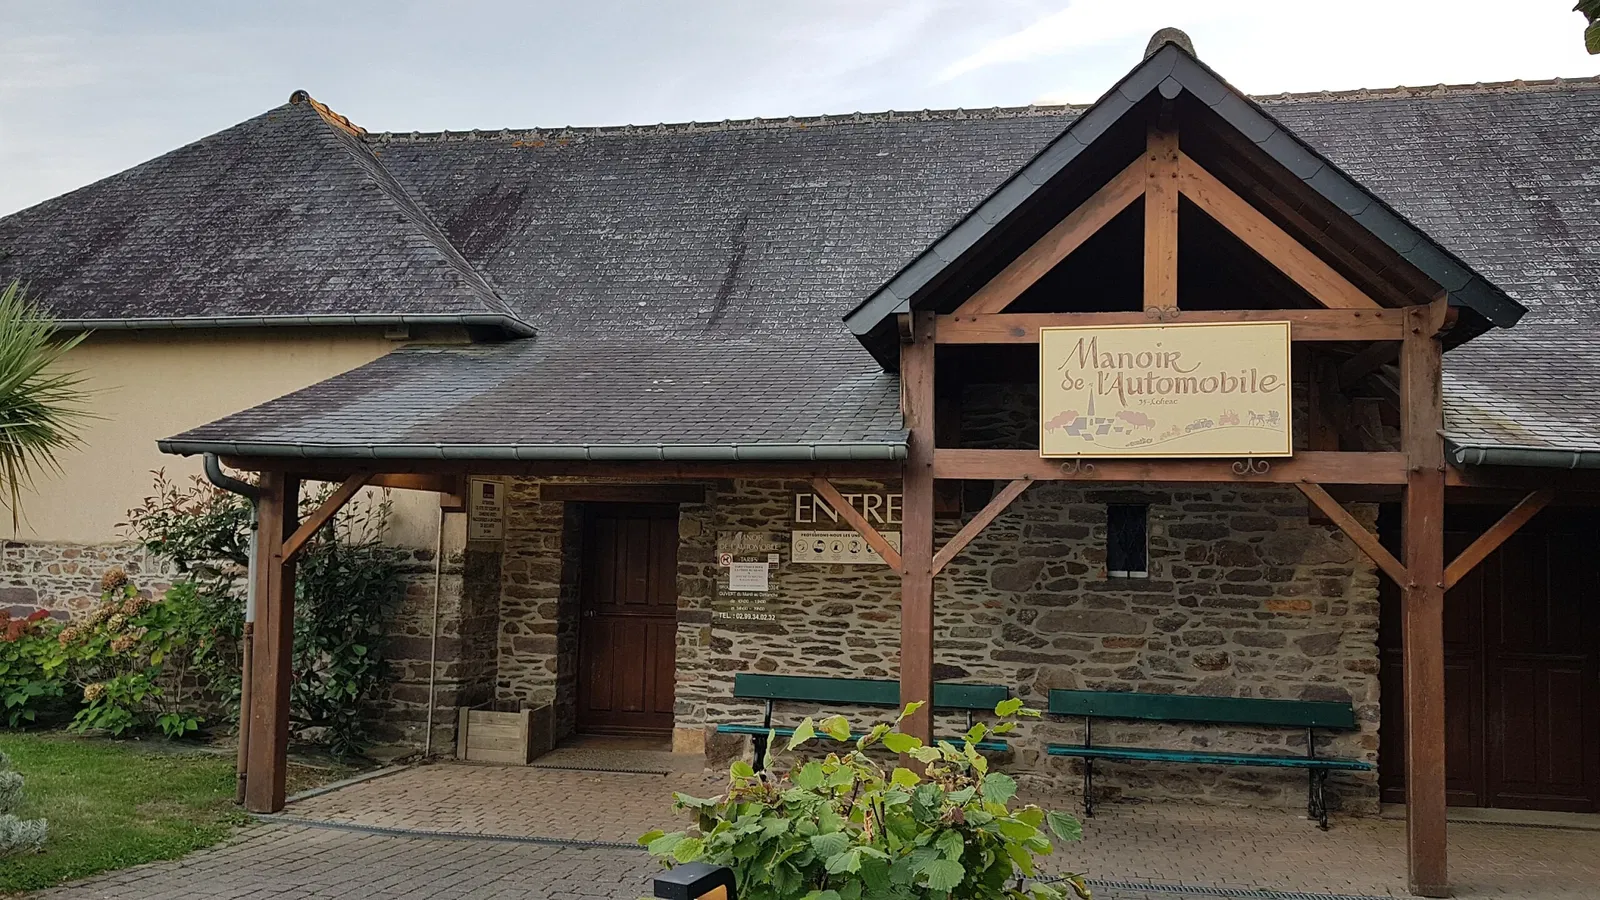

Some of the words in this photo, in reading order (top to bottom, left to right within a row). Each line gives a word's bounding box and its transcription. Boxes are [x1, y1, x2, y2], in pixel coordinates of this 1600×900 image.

[1058, 336, 1201, 373] Manoir
[1061, 370, 1085, 391] de
[1098, 368, 1286, 408] l'Automobile
